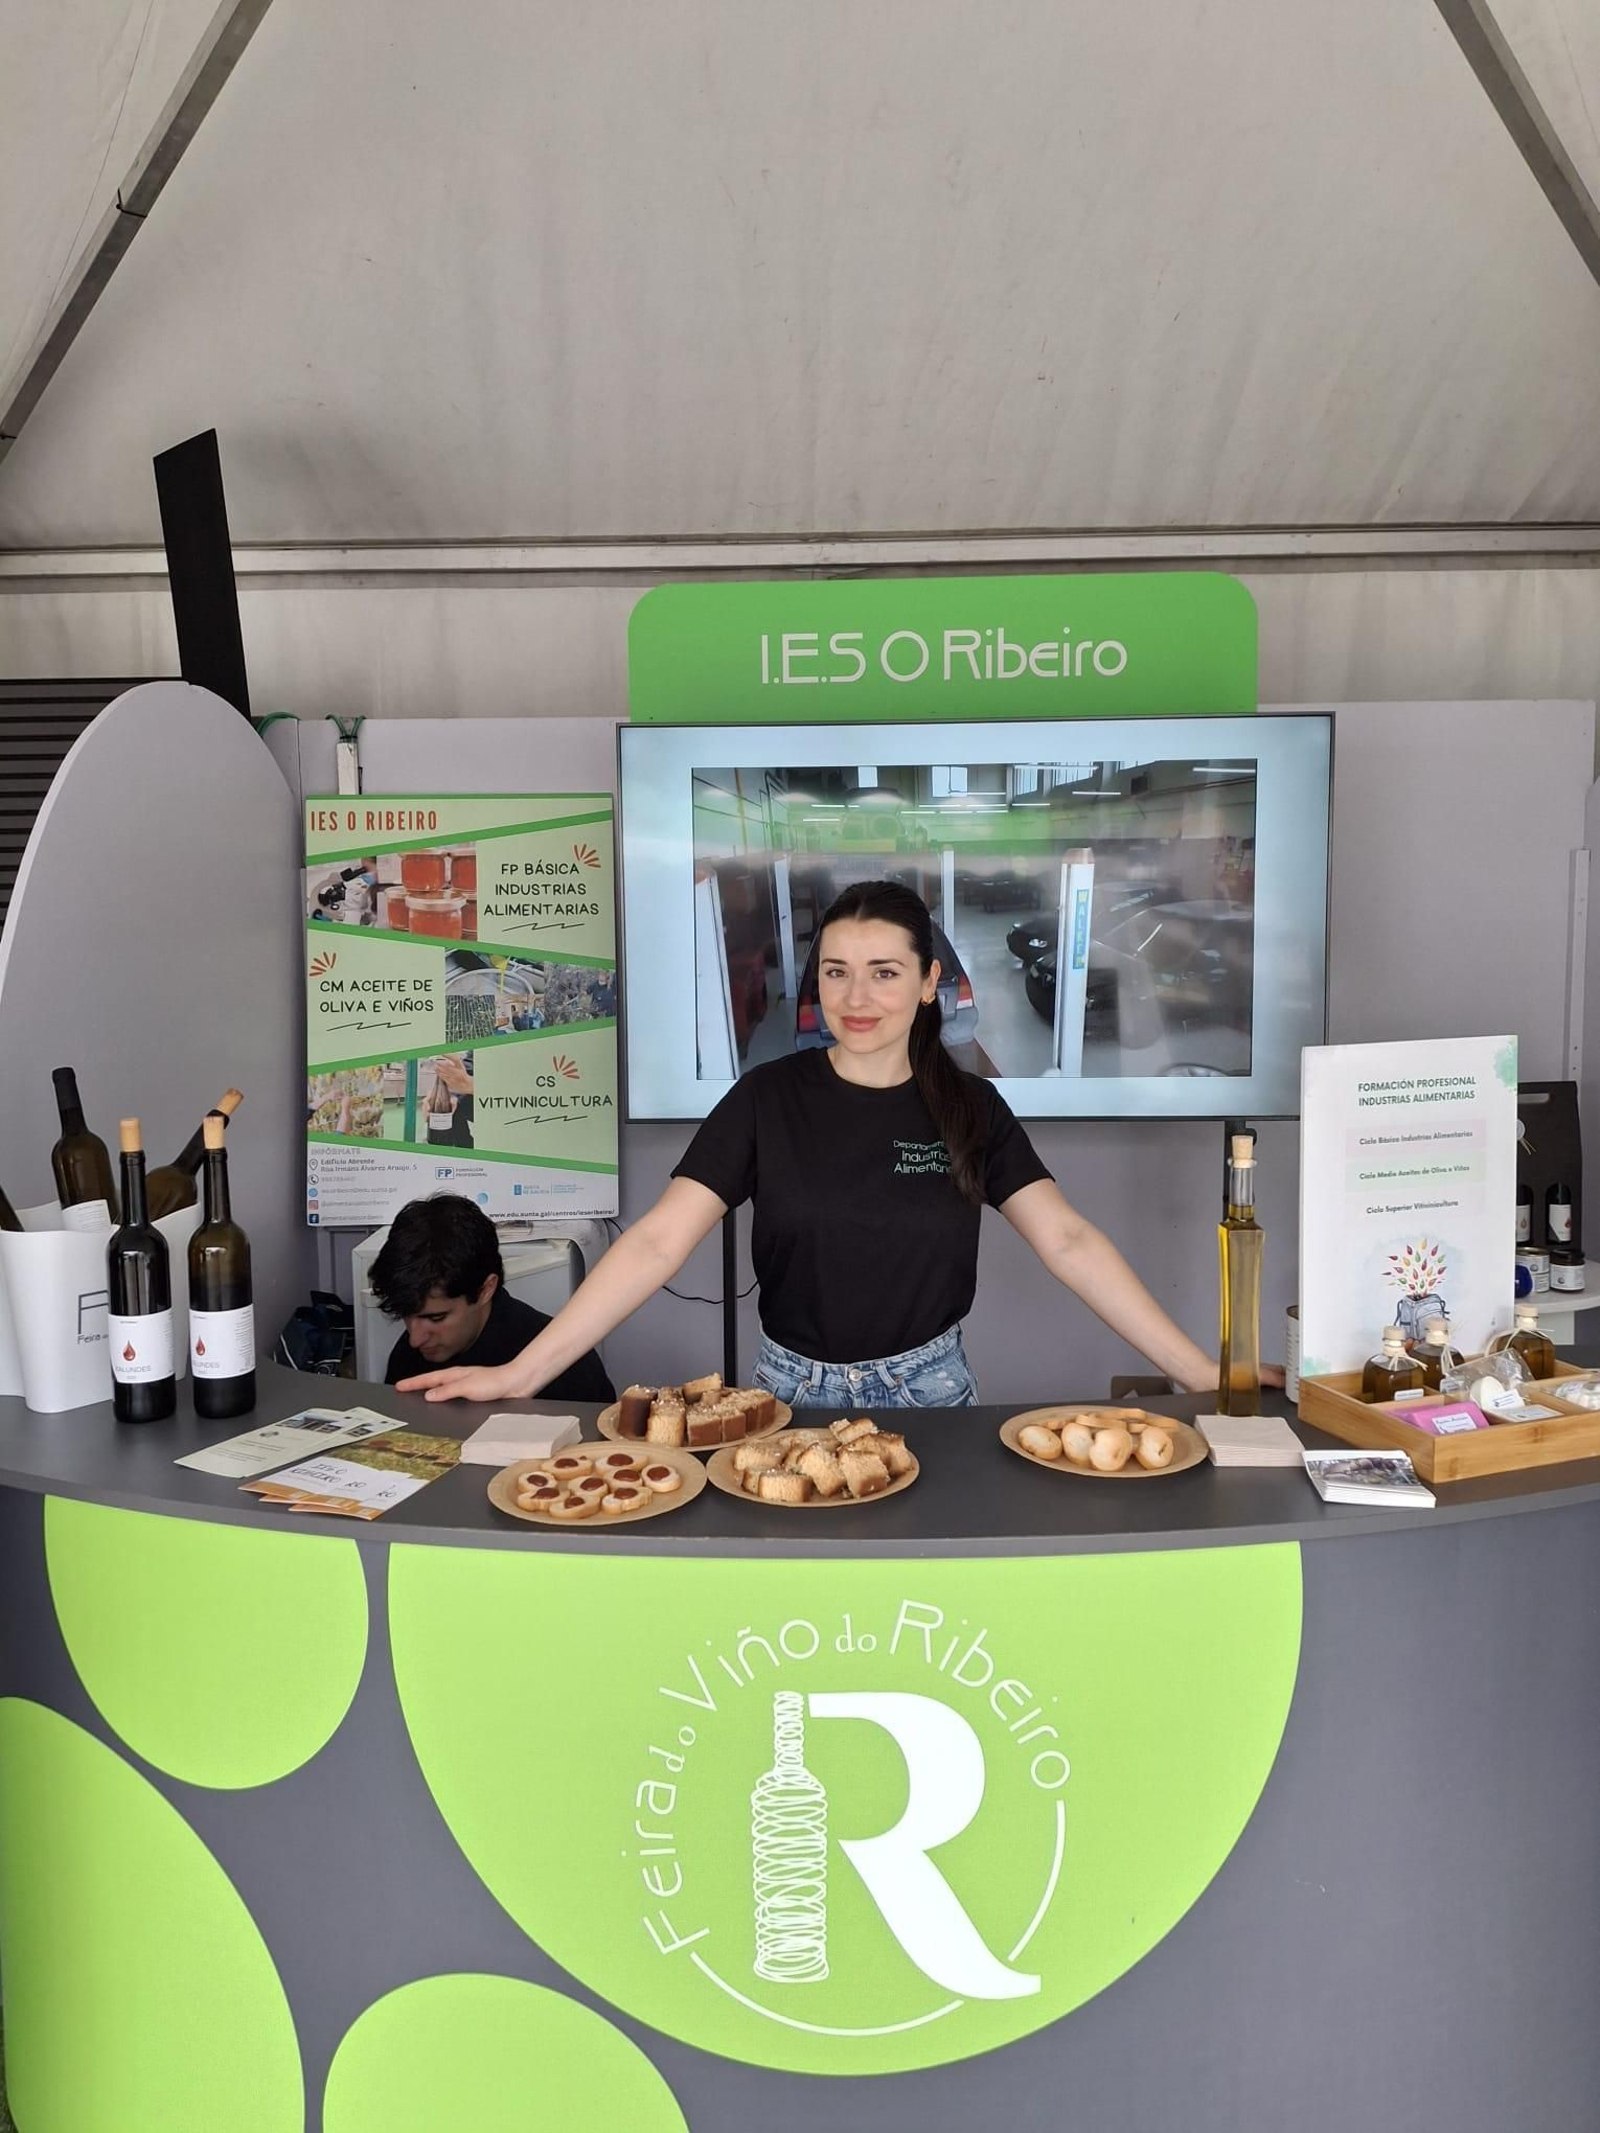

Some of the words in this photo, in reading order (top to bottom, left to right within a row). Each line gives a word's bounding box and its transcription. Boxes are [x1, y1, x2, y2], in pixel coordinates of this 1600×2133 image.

[880, 630, 929, 682] O
[943, 626, 1128, 681] Ribeiro
[310, 810, 339, 832] IES
[346, 810, 357, 832] O
[365, 810, 437, 831] RIBEIRO
[500, 863, 520, 876] FP
[524, 858, 581, 876] BÁSICA
[495, 882, 588, 896] INDUSTRIAS
[483, 903, 600, 917] ALIMENTARIAS
[319, 979, 345, 993] CM
[349, 979, 407, 993] ACEITE
[412, 979, 433, 992] DE
[319, 1000, 367, 1013] OLIVA
[372, 1000, 382, 1013] E
[387, 997, 435, 1013] VIÑOS
[535, 1075, 556, 1088] CS
[1358, 1079, 1415, 1092] FORMACIÓN
[1416, 1076, 1477, 1089] PROFESIONAL
[478, 1094, 614, 1109] VITIVINICULTURA
[1358, 1094, 1411, 1107] INDUSTRIAS
[1413, 1090, 1476, 1104] ALIMENTARIAS
[1401, 1133, 1432, 1143] Industrias
[1433, 1131, 1474, 1140] Alimentarias
[437, 1168, 453, 1178] FP
[1359, 1172, 1376, 1180] Ciclo
[1366, 1206, 1384, 1215] Ciclo
[1385, 1204, 1413, 1214] Superior
[77, 1333, 101, 1345] Feira
[835, 1613, 877, 1653] do
[659, 1619, 820, 1712] Viño
[890, 1599, 1071, 1790] Ribeiro
[649, 1725, 696, 1773] do
[621, 1779, 710, 1955] Feira
